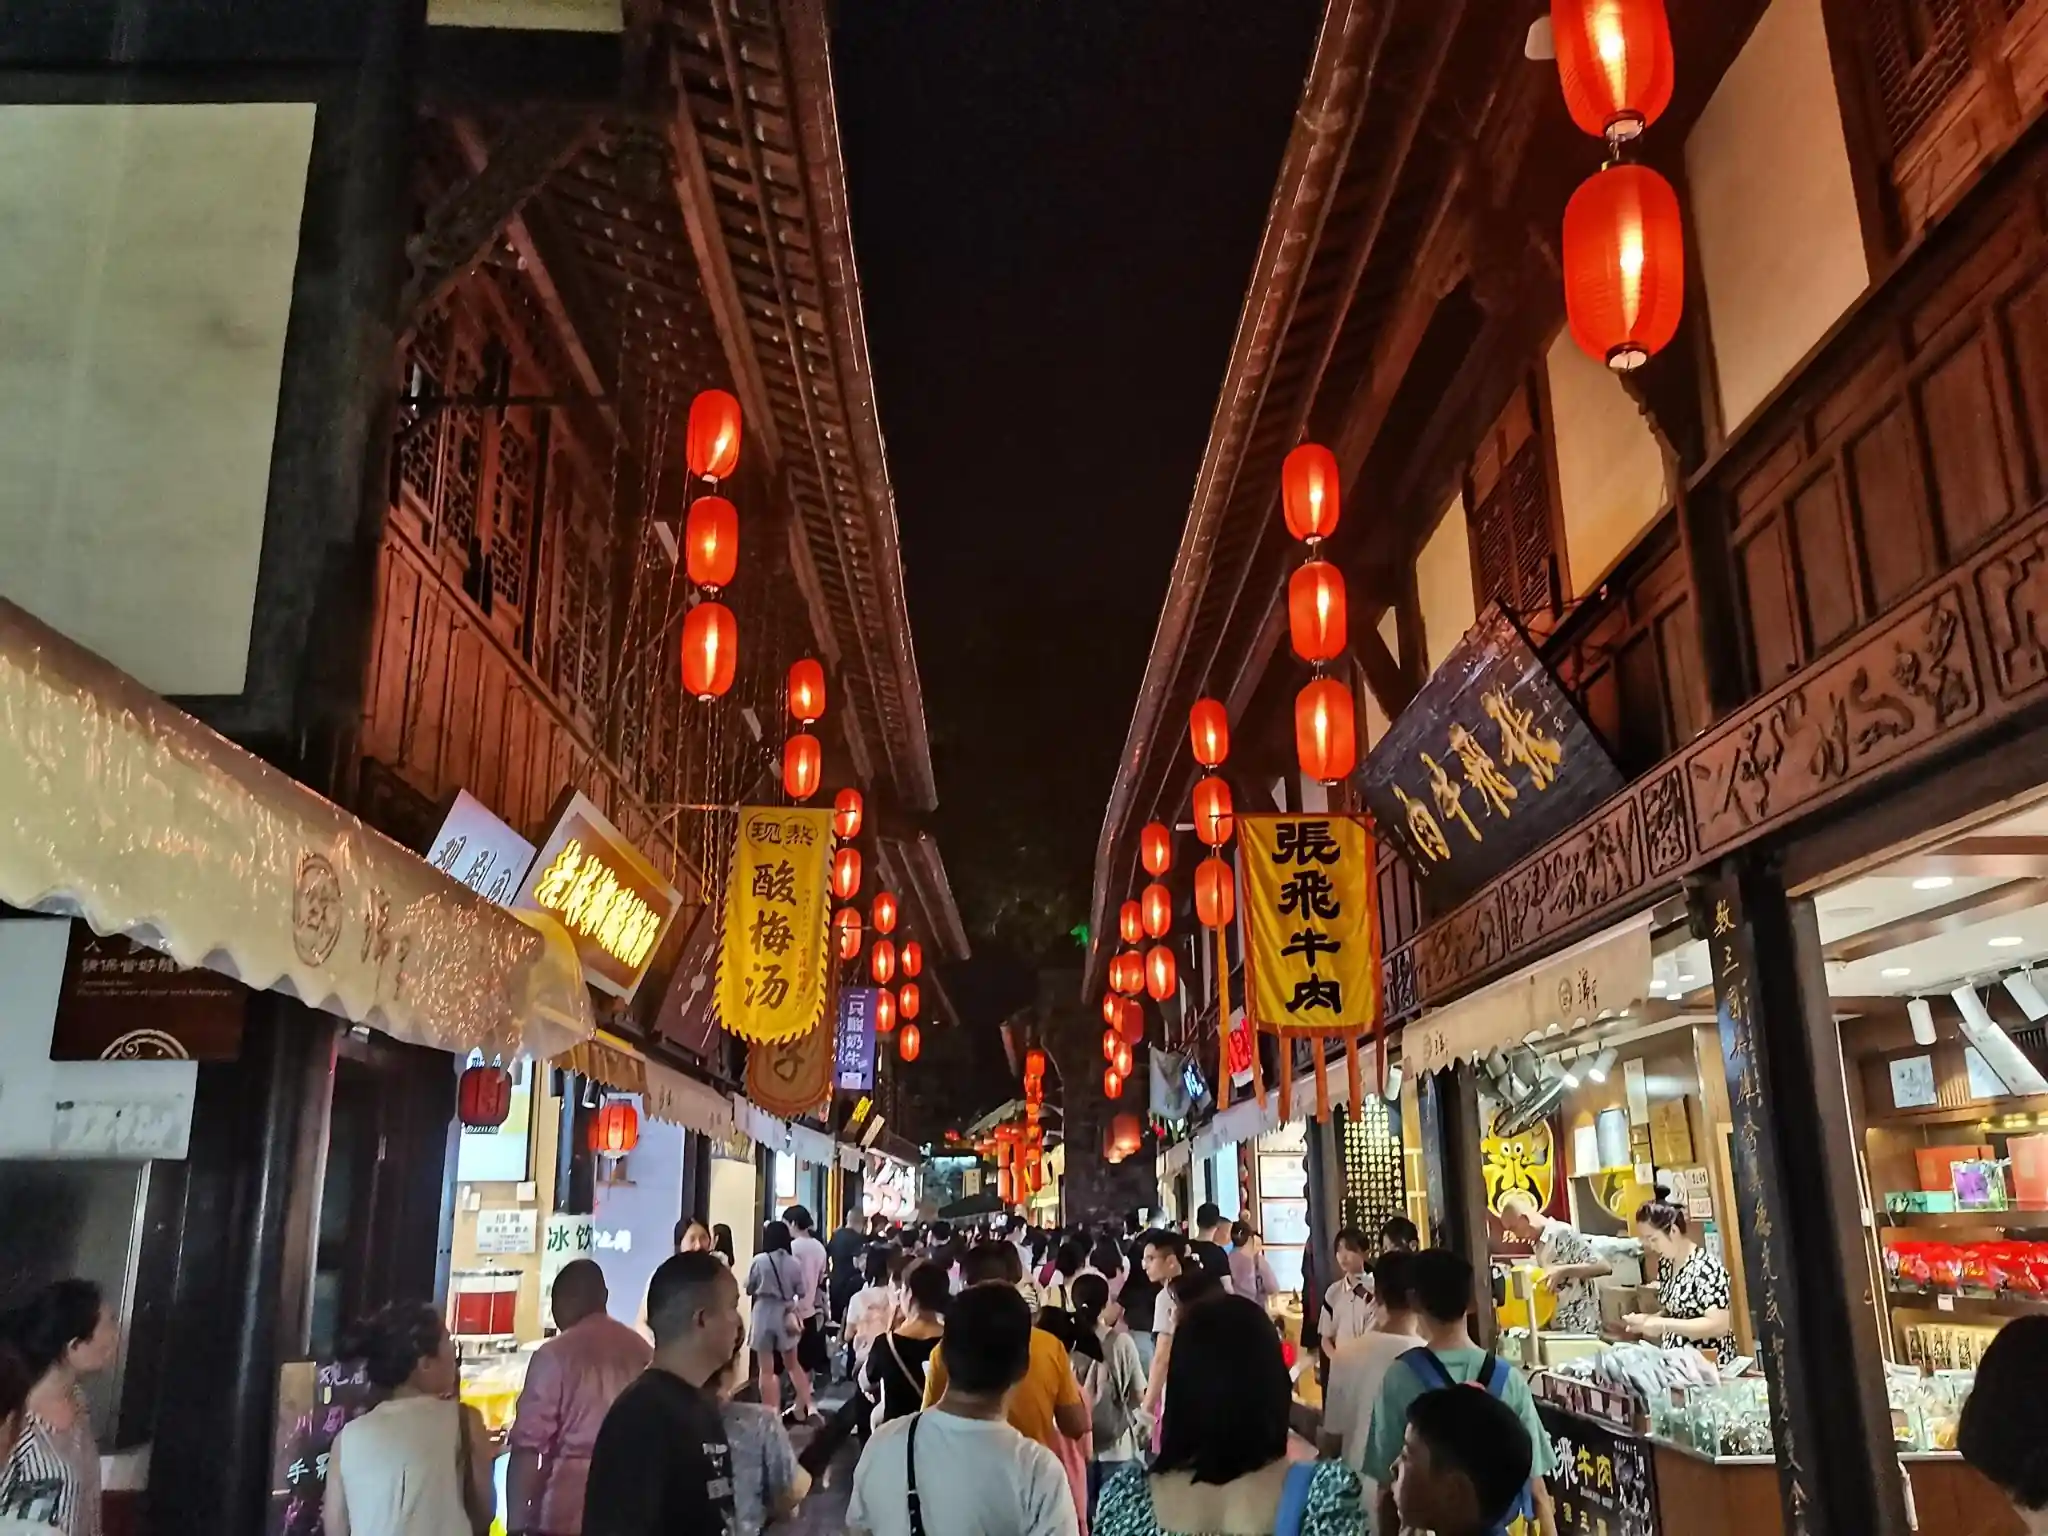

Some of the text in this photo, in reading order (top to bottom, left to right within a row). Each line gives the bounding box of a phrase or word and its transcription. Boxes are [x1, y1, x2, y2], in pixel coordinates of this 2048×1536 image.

[750, 821, 814, 848] 现熬
[743, 859, 797, 1011] 酸梅汤
[1271, 820, 1342, 1016] 張飛牛肉
[547, 1223, 594, 1252] 冰饮
